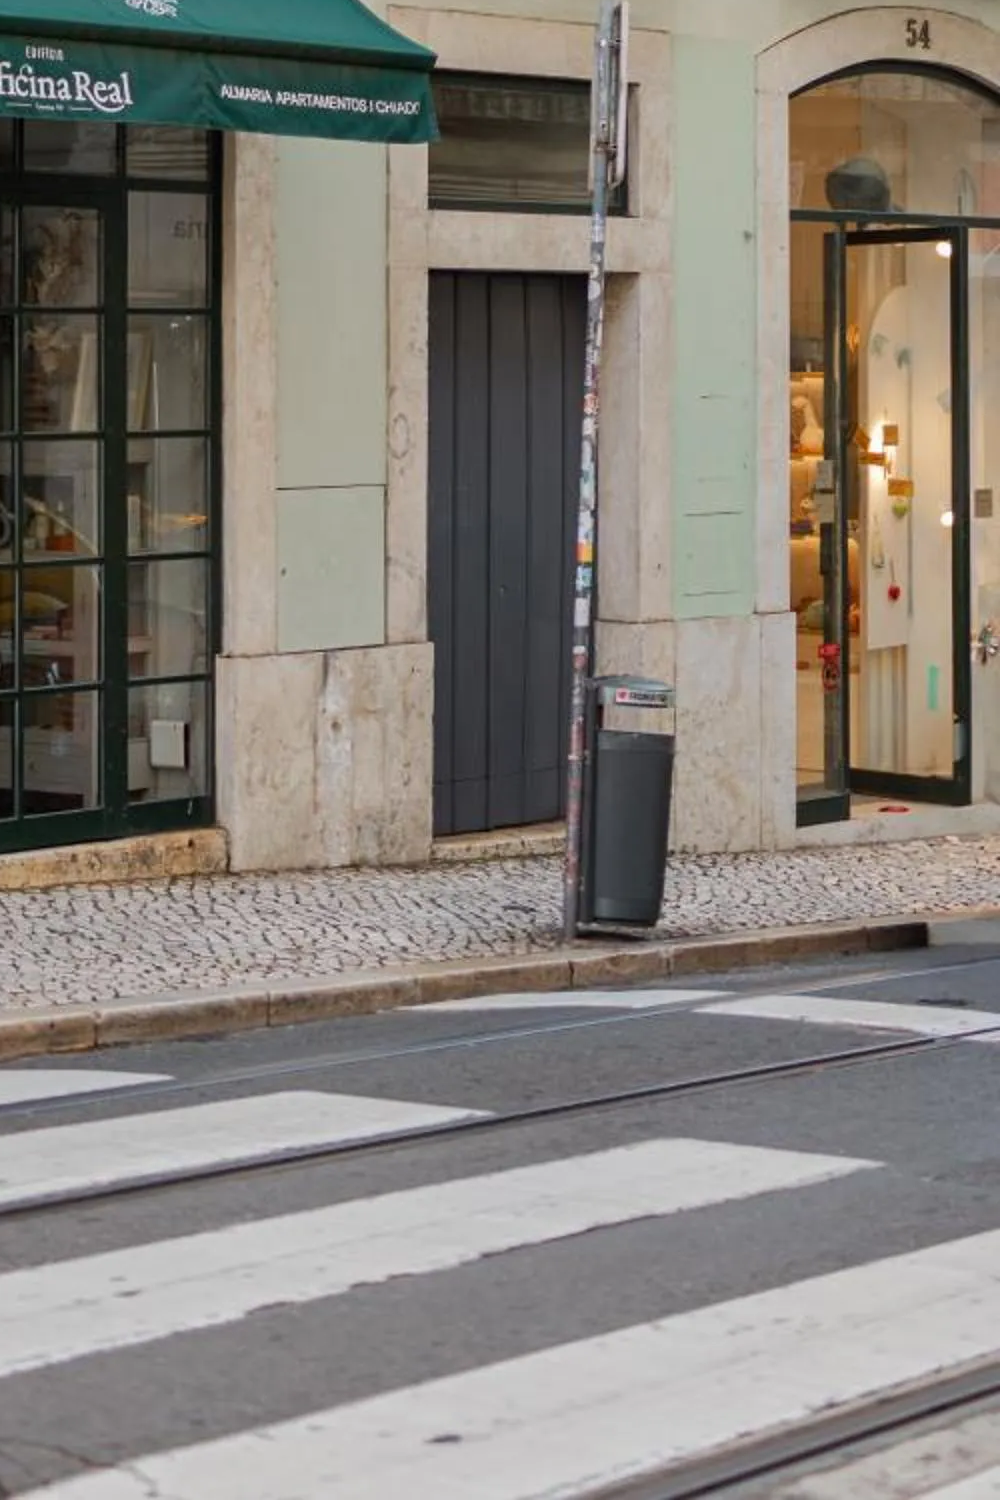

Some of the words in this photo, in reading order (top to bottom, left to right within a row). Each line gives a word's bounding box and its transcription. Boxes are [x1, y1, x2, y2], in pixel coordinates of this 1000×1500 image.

[906, 19, 931, 49] 54
[72, 71, 133, 113] Real
[221, 84, 272, 103] ALMARIA
[275, 91, 367, 112] APARTAMENTOS
[376, 100, 421, 115] CHIADO
